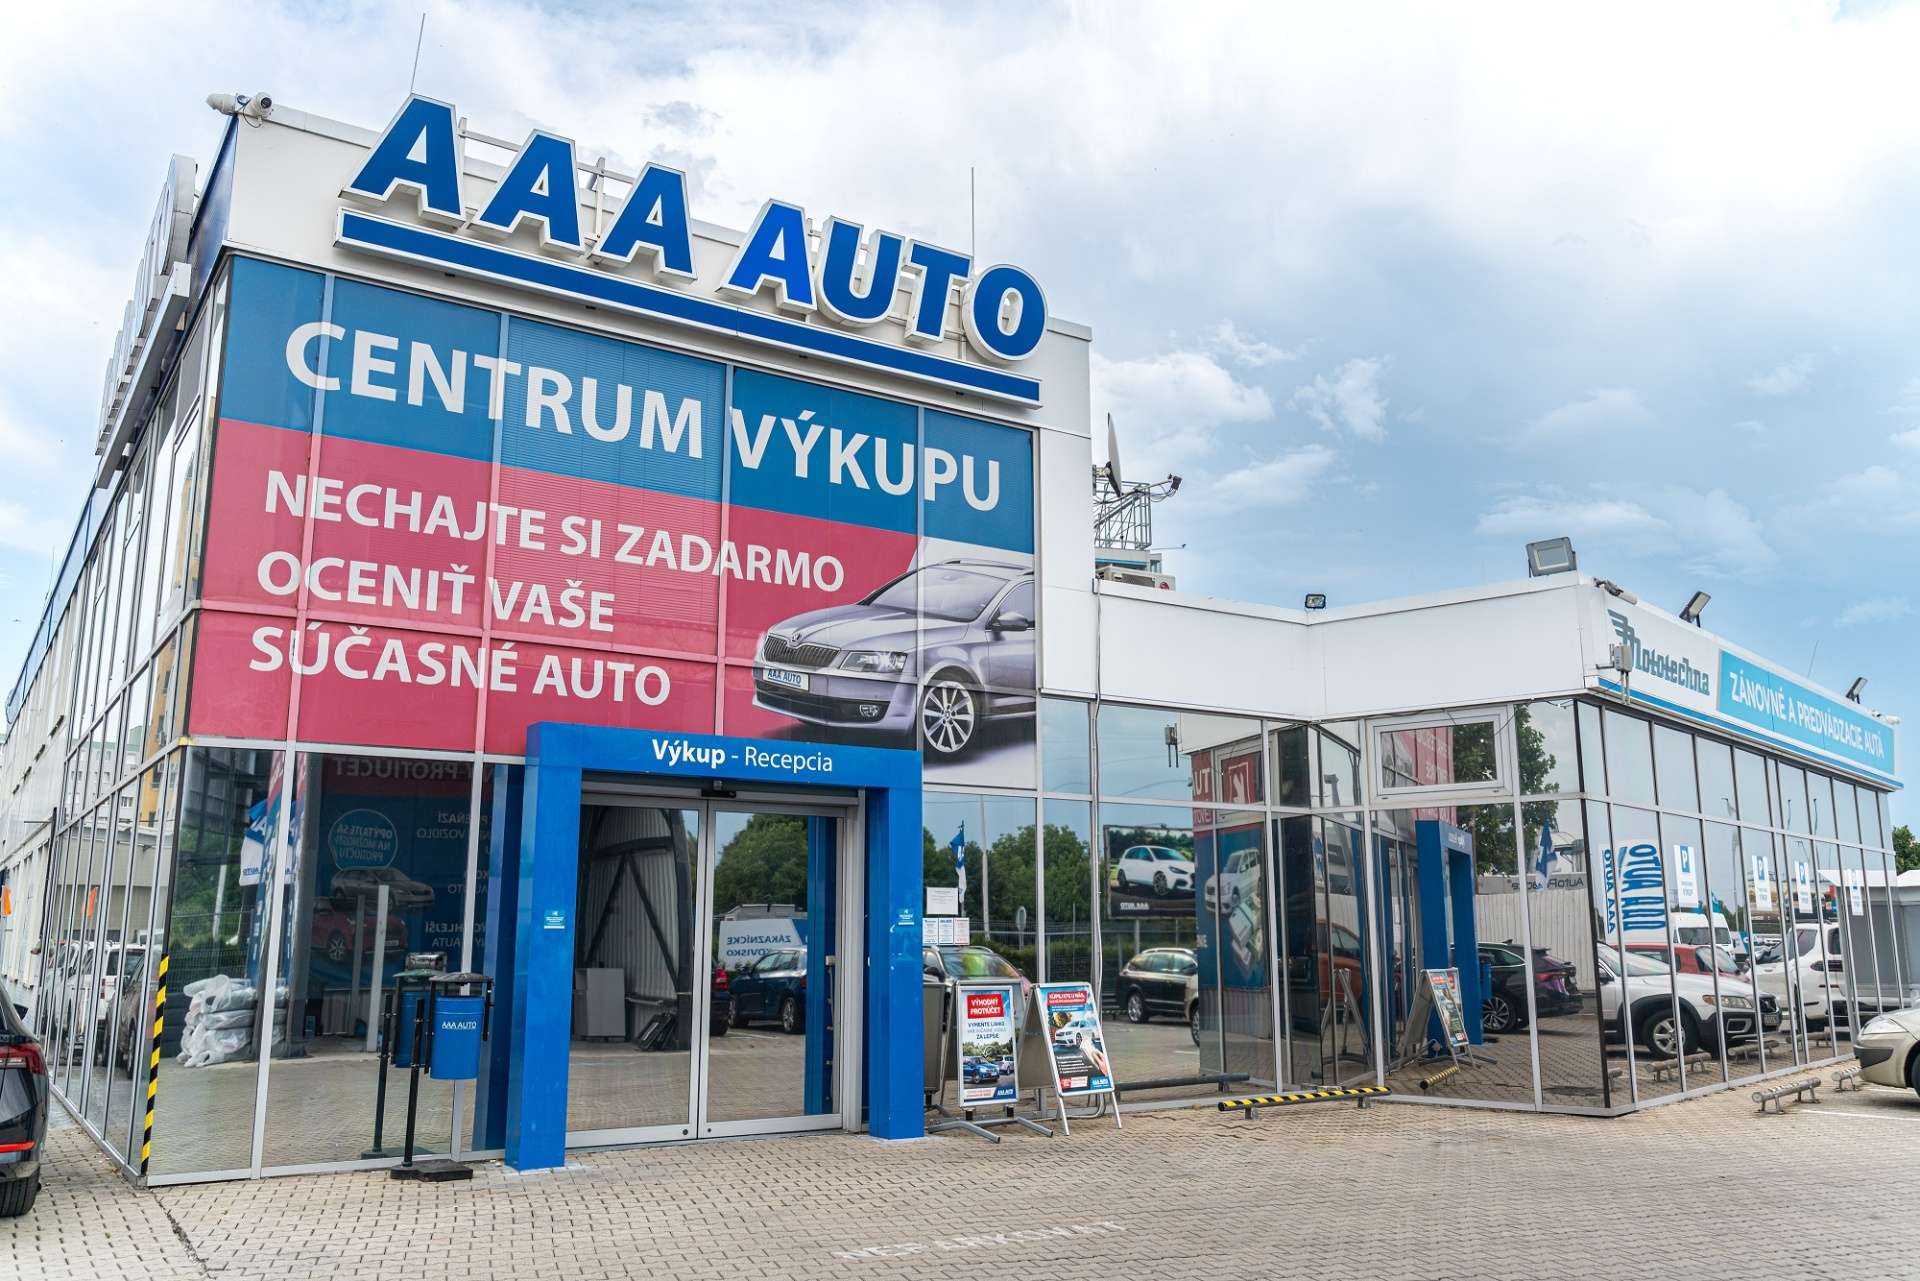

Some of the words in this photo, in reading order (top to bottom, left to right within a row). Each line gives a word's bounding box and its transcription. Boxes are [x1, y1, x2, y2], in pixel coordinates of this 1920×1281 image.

[341, 94, 697, 282] AAA
[717, 199, 1047, 361] AUTO
[285, 321, 703, 459] CENTRUM
[730, 408, 1000, 511] VÝKUPU
[265, 470, 546, 550] NECHAJTE
[560, 516, 601, 558] SI
[614, 523, 845, 592] ZADARMO
[257, 551, 475, 615] OCENIŤ
[488, 578, 615, 632] VAŠE
[249, 620, 518, 693] SÚČASNÉ
[532, 654, 671, 706] AUTO
[768, 668, 782, 679] AAA
[783, 671, 801, 684] AUTO
[652, 739, 726, 769] Výkup
[745, 747, 833, 774] Recepcia
[1730, 669, 1787, 720] ZÁNOVNÉ
[1788, 697, 1797, 724] A
[1797, 701, 1863, 751] PREDVÁDZACIE
[1864, 729, 1885, 760] AUTÁ
[442, 1021, 456, 1029] AAA
[457, 1020, 476, 1029] AUTO
